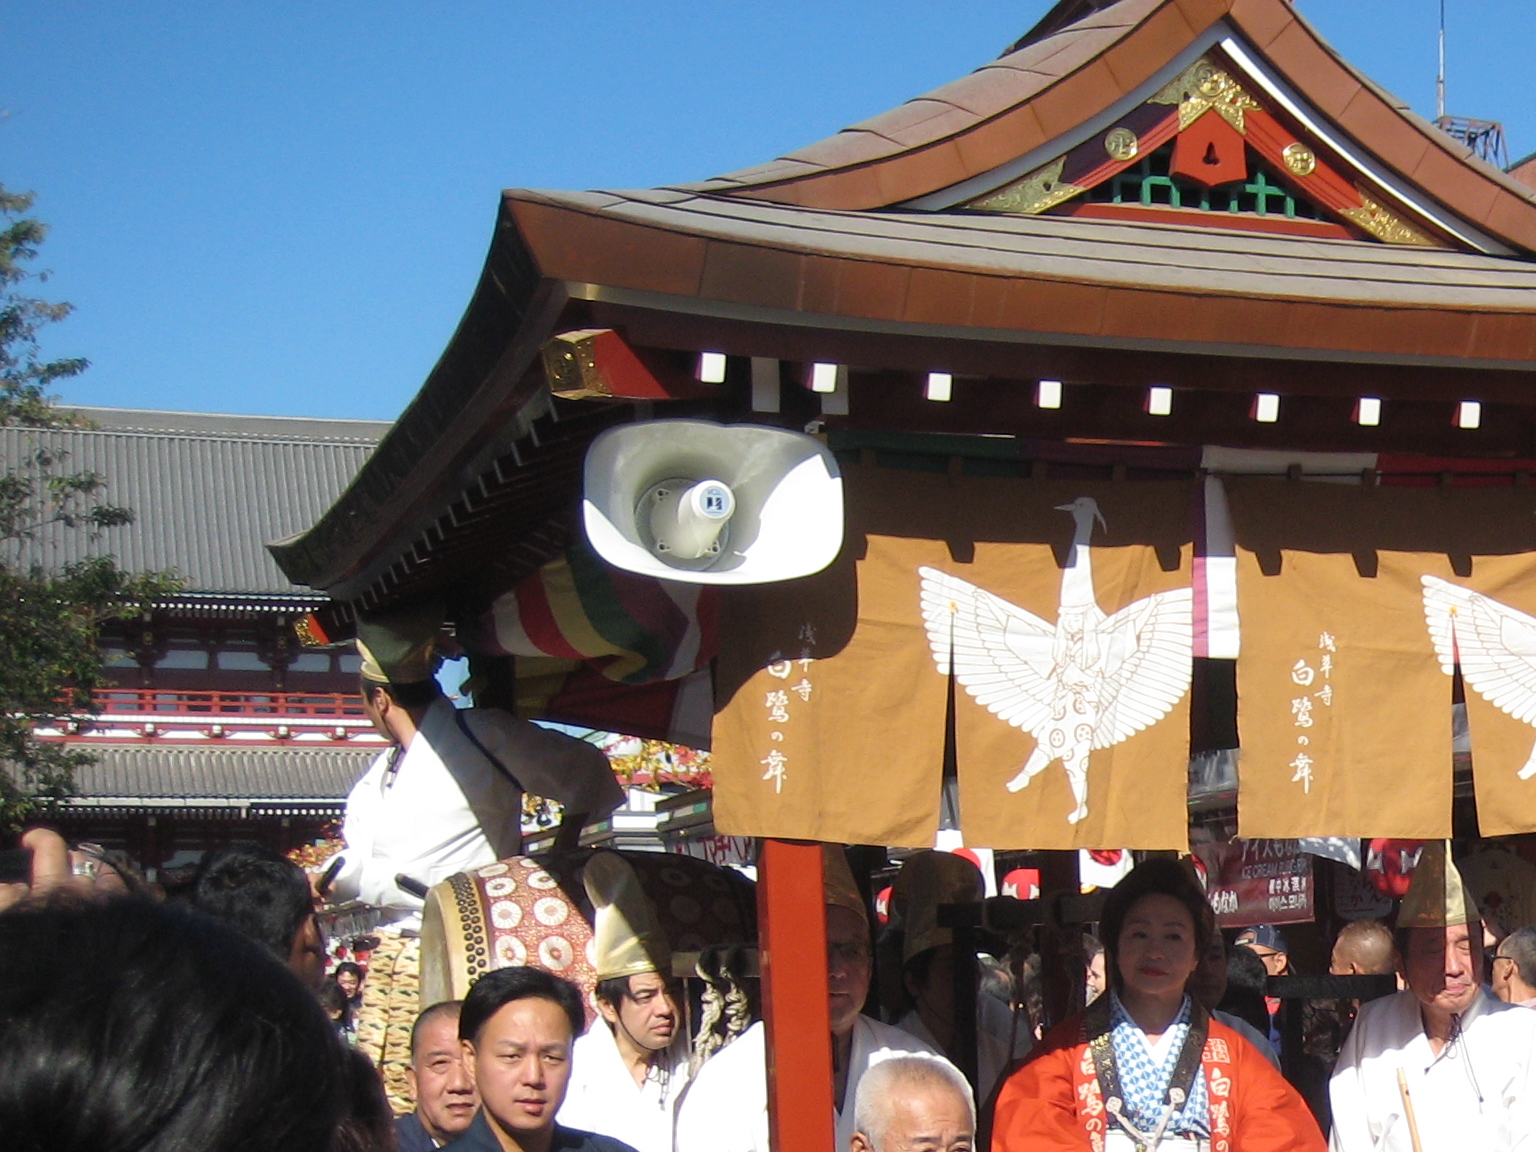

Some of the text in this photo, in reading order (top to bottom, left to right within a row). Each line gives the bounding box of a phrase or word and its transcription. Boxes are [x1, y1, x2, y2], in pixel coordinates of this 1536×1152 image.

[760, 650, 793, 795] 白鷺の舞
[1289, 659, 1315, 795] 白鷺の舞
[1314, 631, 1337, 707] 浅草寺
